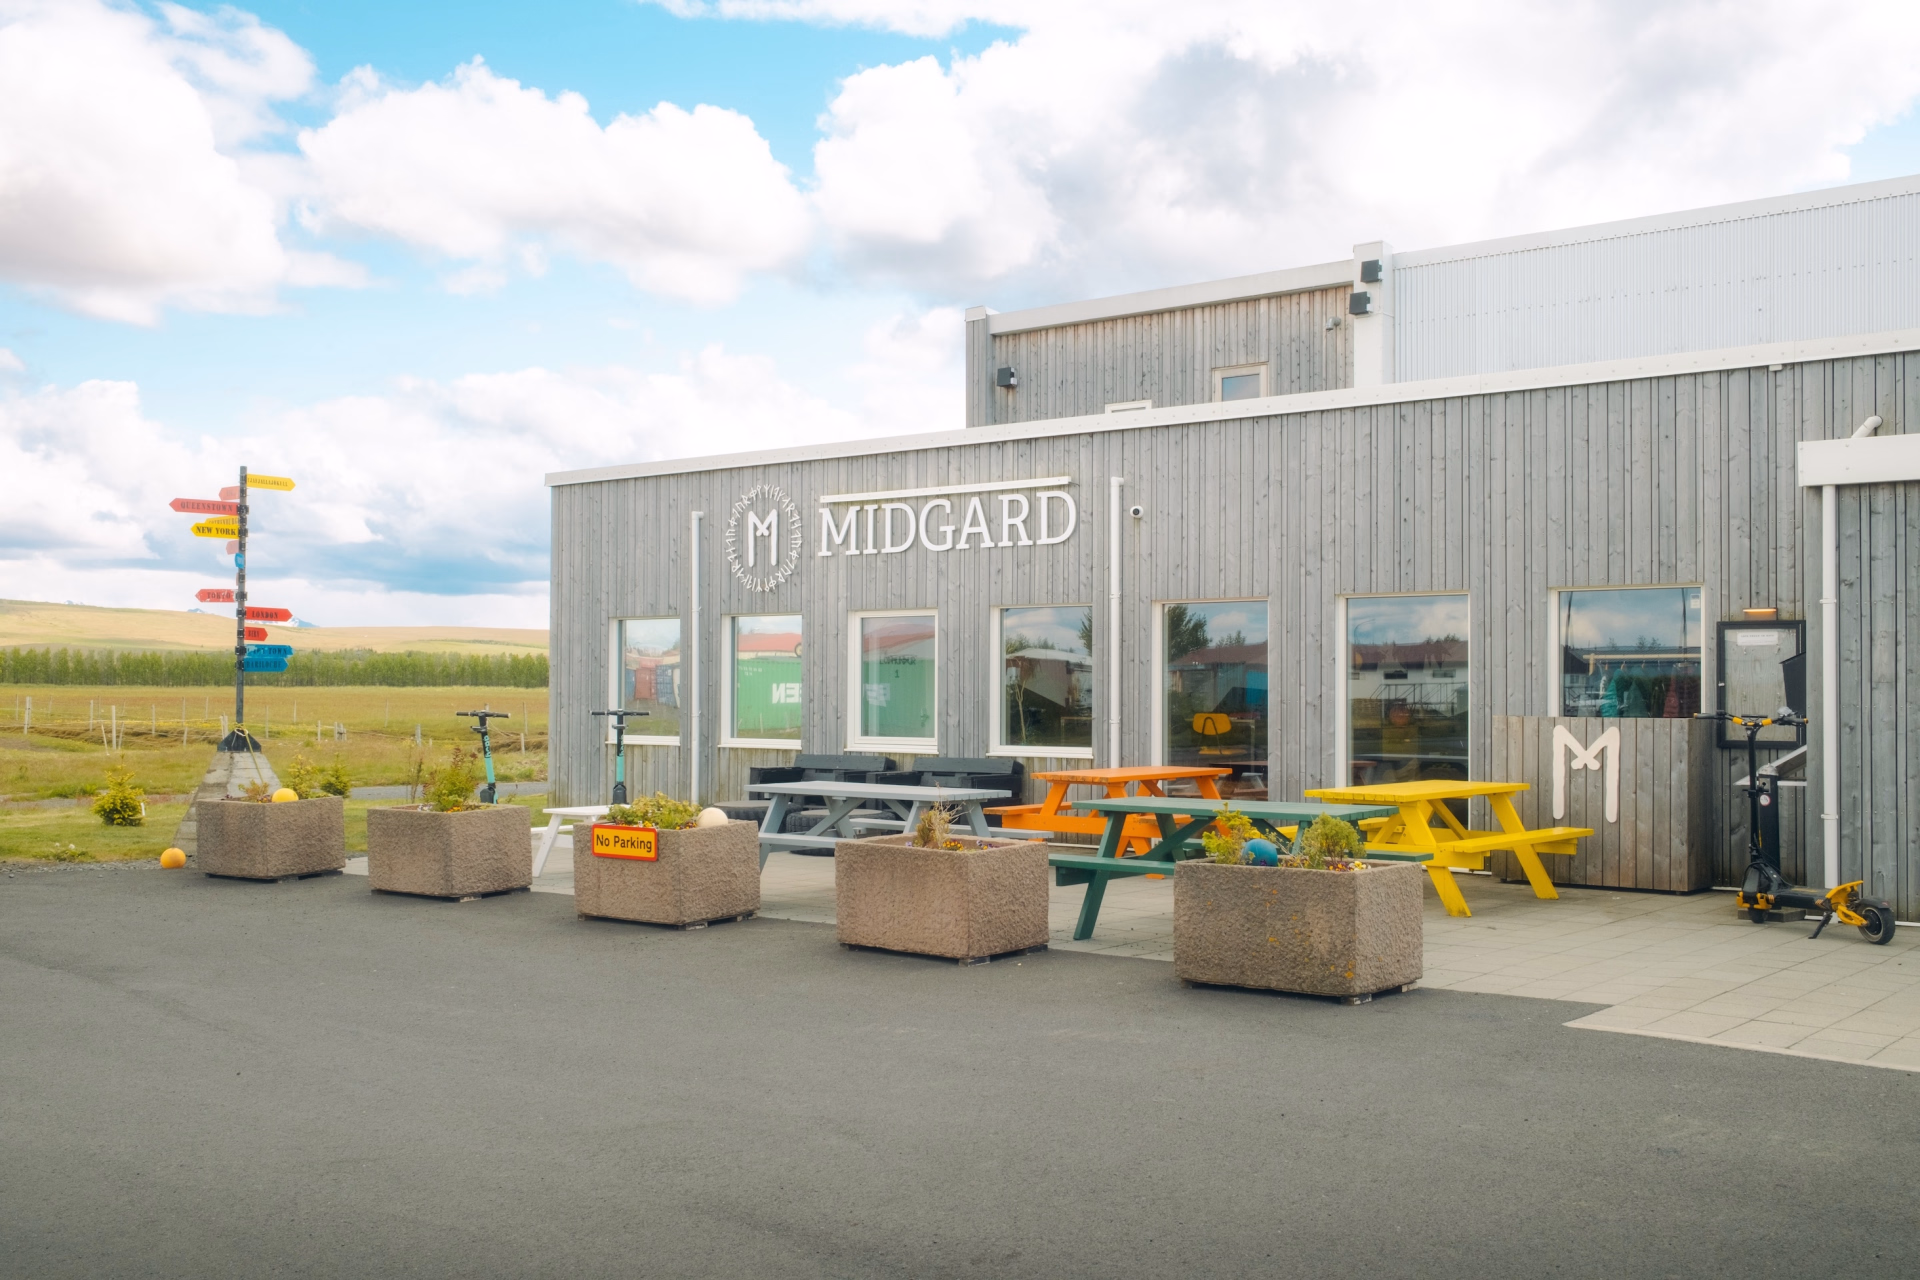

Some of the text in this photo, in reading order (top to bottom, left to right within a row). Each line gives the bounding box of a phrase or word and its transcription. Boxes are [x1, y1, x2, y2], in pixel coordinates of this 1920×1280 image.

[180, 501, 233, 512] QUEENSTOWN
[818, 490, 1077, 557] MIDGARD
[196, 525, 237, 536] NEW YORK
[206, 591, 231, 600] TOKYO
[251, 610, 279, 619] LONDON
[267, 646, 287, 656] TOWN
[596, 833, 653, 854] No Parking
